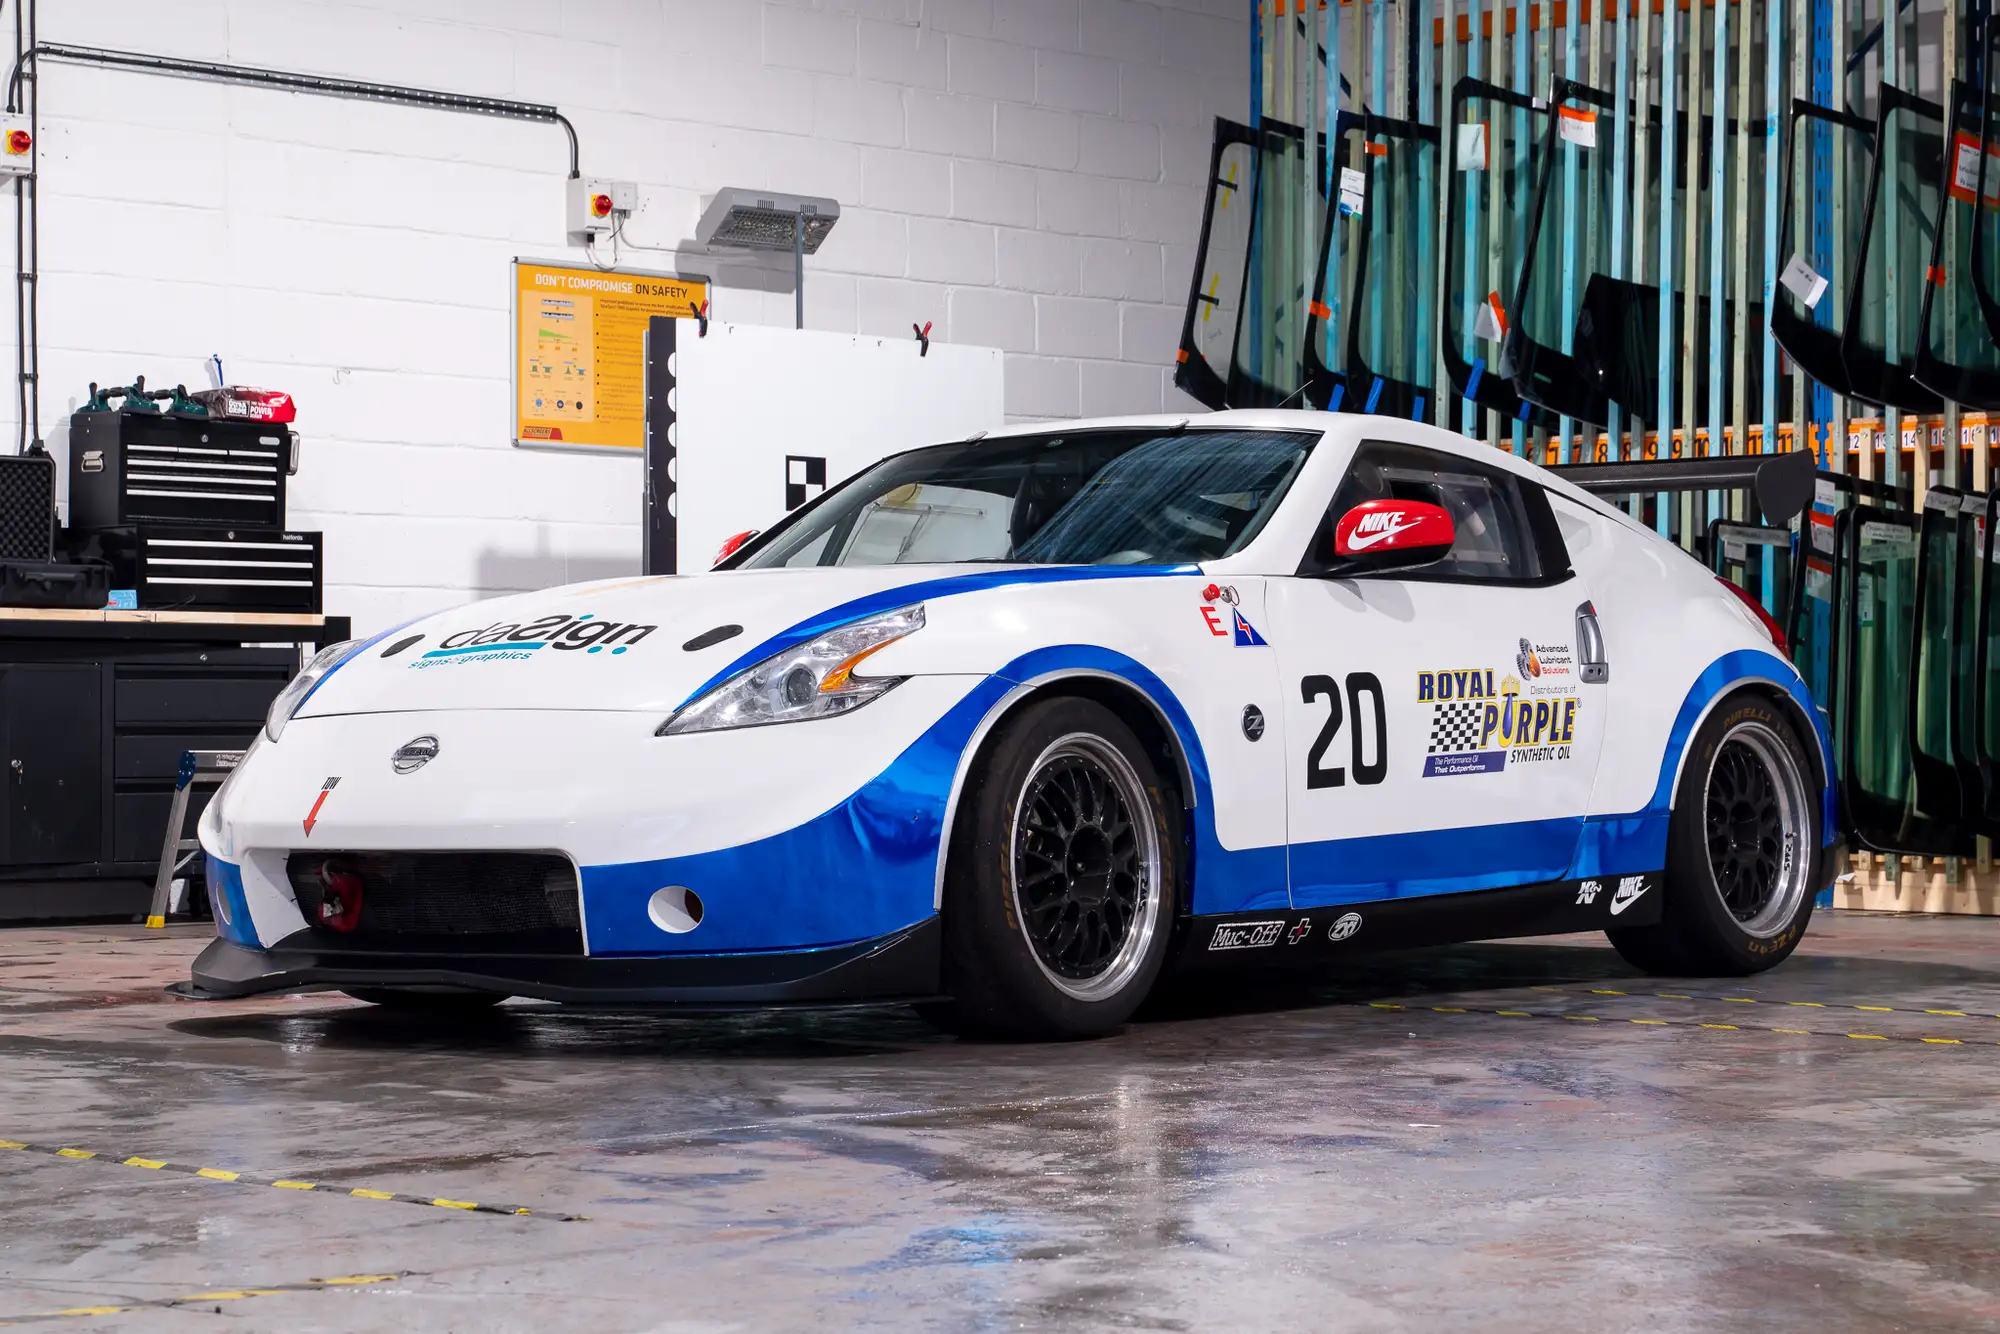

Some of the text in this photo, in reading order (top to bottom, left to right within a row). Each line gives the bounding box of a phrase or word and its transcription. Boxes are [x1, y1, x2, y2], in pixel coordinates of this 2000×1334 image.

[535, 273, 688, 299] DON'T COMPROMISE ON SAFETY
[1356, 511, 1406, 533] NIKE
[1200, 606, 1228, 636] E
[1536, 644, 1569, 653] Advanced
[1539, 655, 1572, 664] Lubricant
[1542, 666, 1570, 675] Solutions
[1417, 668, 1498, 703] ROYAL
[1530, 684, 1576, 695] Distributors of
[1301, 671, 1387, 790] 20
[1443, 756, 1472, 765] Performance
[1510, 746, 1571, 763] SYNTHETIC OIL
[1434, 764, 1486, 774] That Outperforms
[1616, 875, 1645, 898] NIKE
[1212, 924, 1280, 947] Muc-Off
